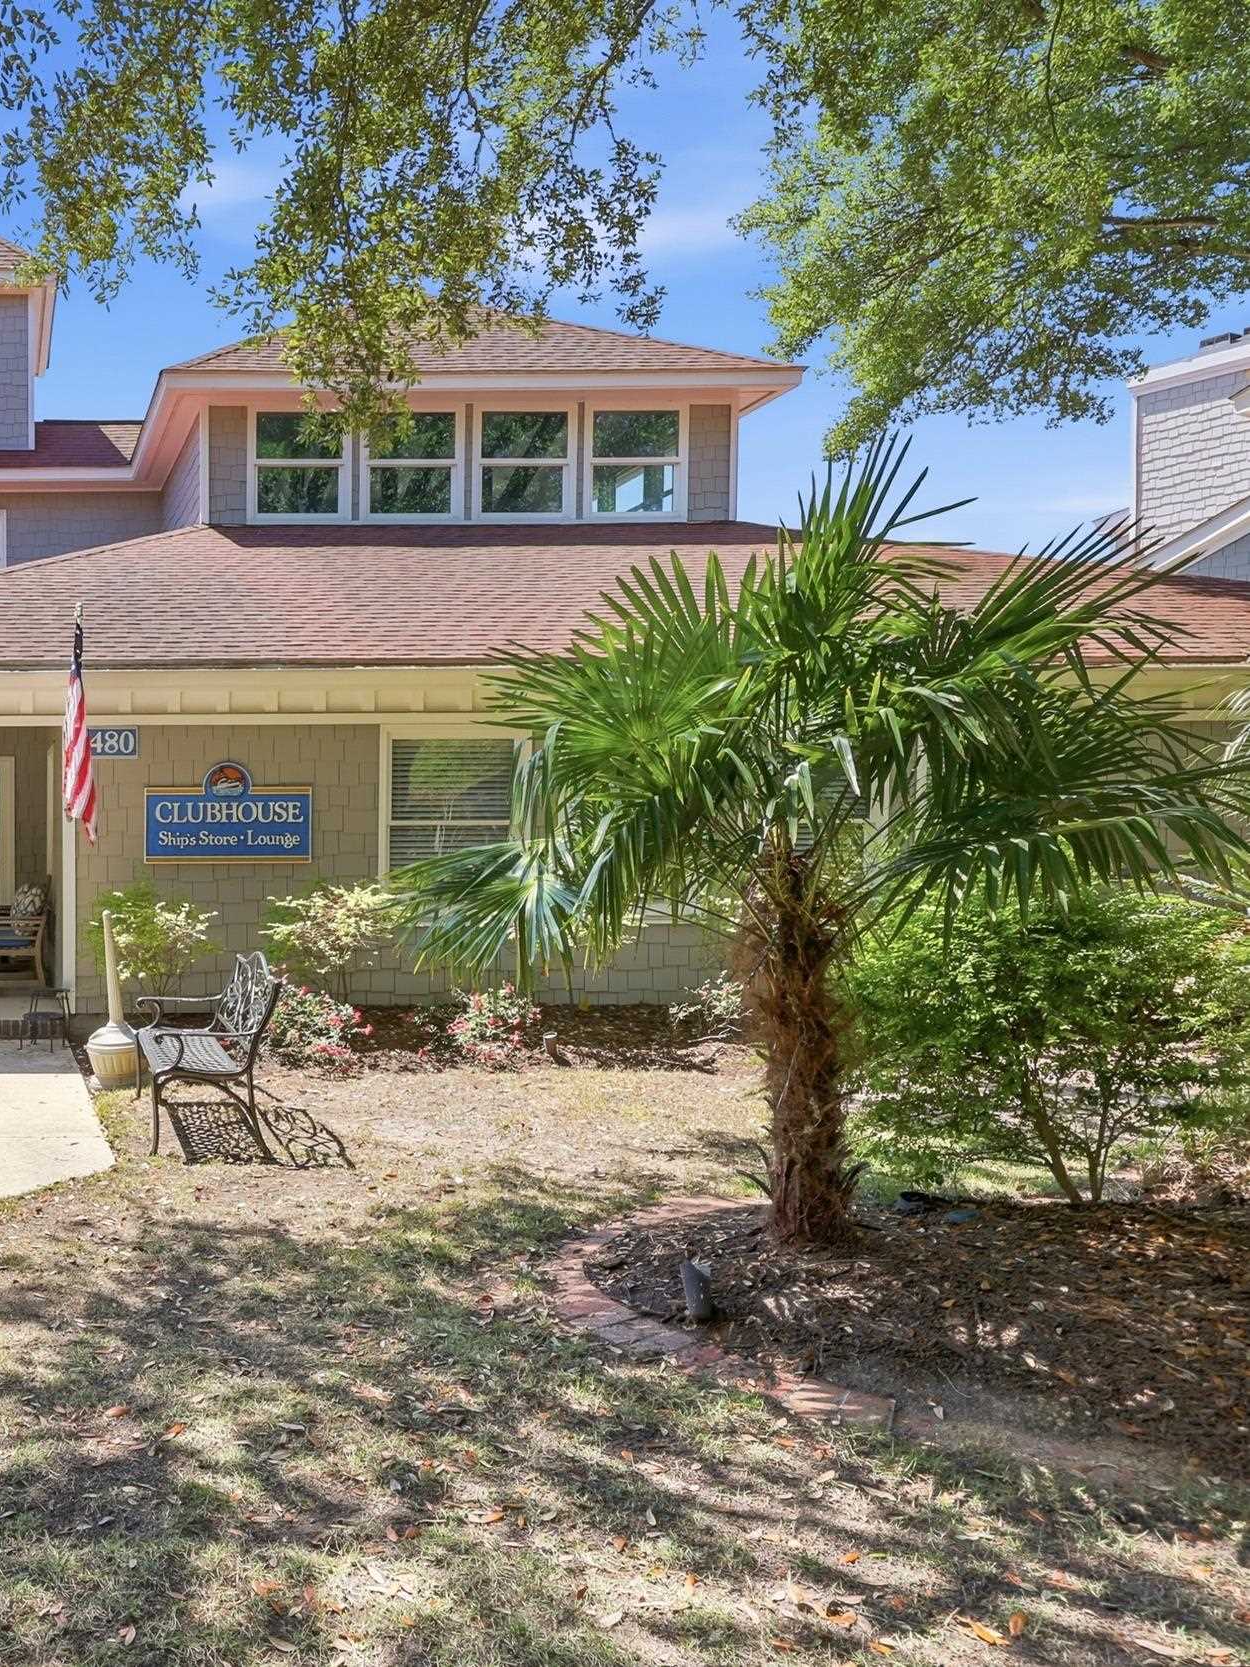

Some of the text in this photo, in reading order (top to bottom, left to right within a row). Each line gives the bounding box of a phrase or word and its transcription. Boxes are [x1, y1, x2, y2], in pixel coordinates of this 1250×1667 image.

[90, 731, 135, 753] 480
[155, 802, 303, 823] CLUBHOUSE
[158, 830, 301, 849] Ship's Store Lounge
